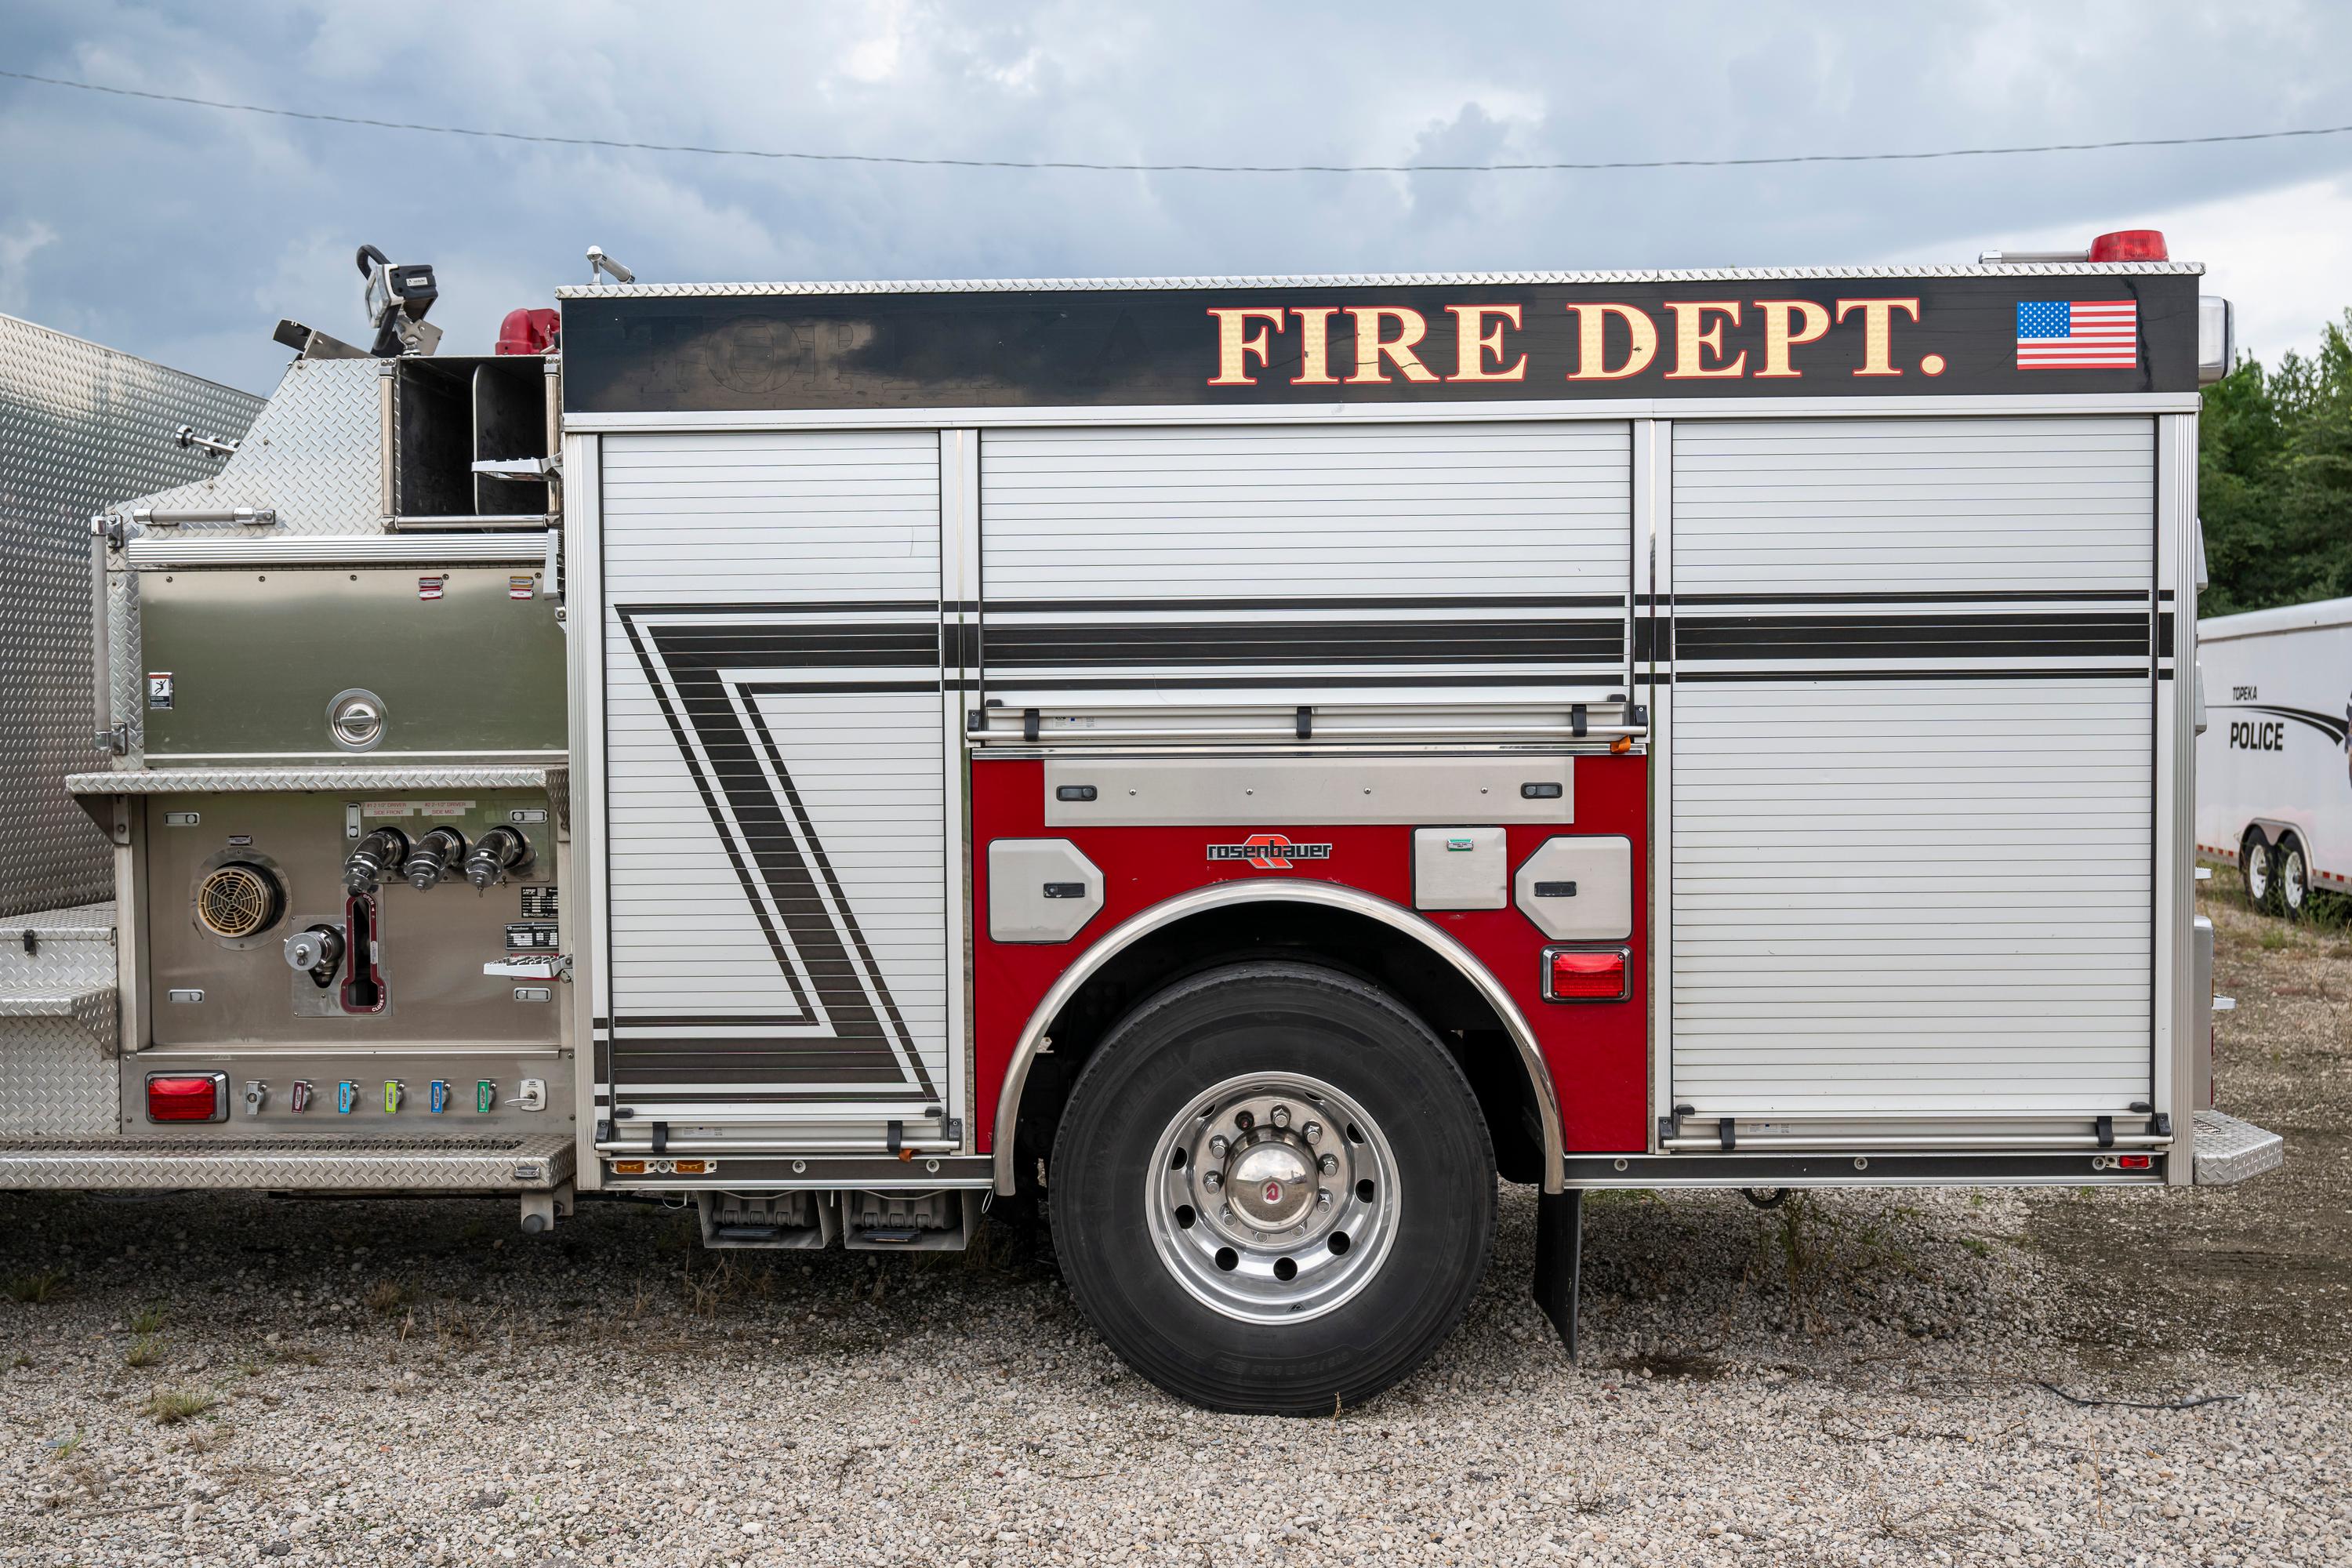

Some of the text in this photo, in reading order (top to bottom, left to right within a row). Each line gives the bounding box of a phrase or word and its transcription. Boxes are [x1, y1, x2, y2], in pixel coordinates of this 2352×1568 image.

[1207, 297, 1947, 385] FIRE DEPT.
[2233, 686, 2257, 701] TOPEKA
[2230, 722, 2284, 751] POLICE
[1207, 838, 1332, 860] rosenbauer
[363, 894, 375, 906] OPEN
[372, 999, 384, 1012] CLOSE
